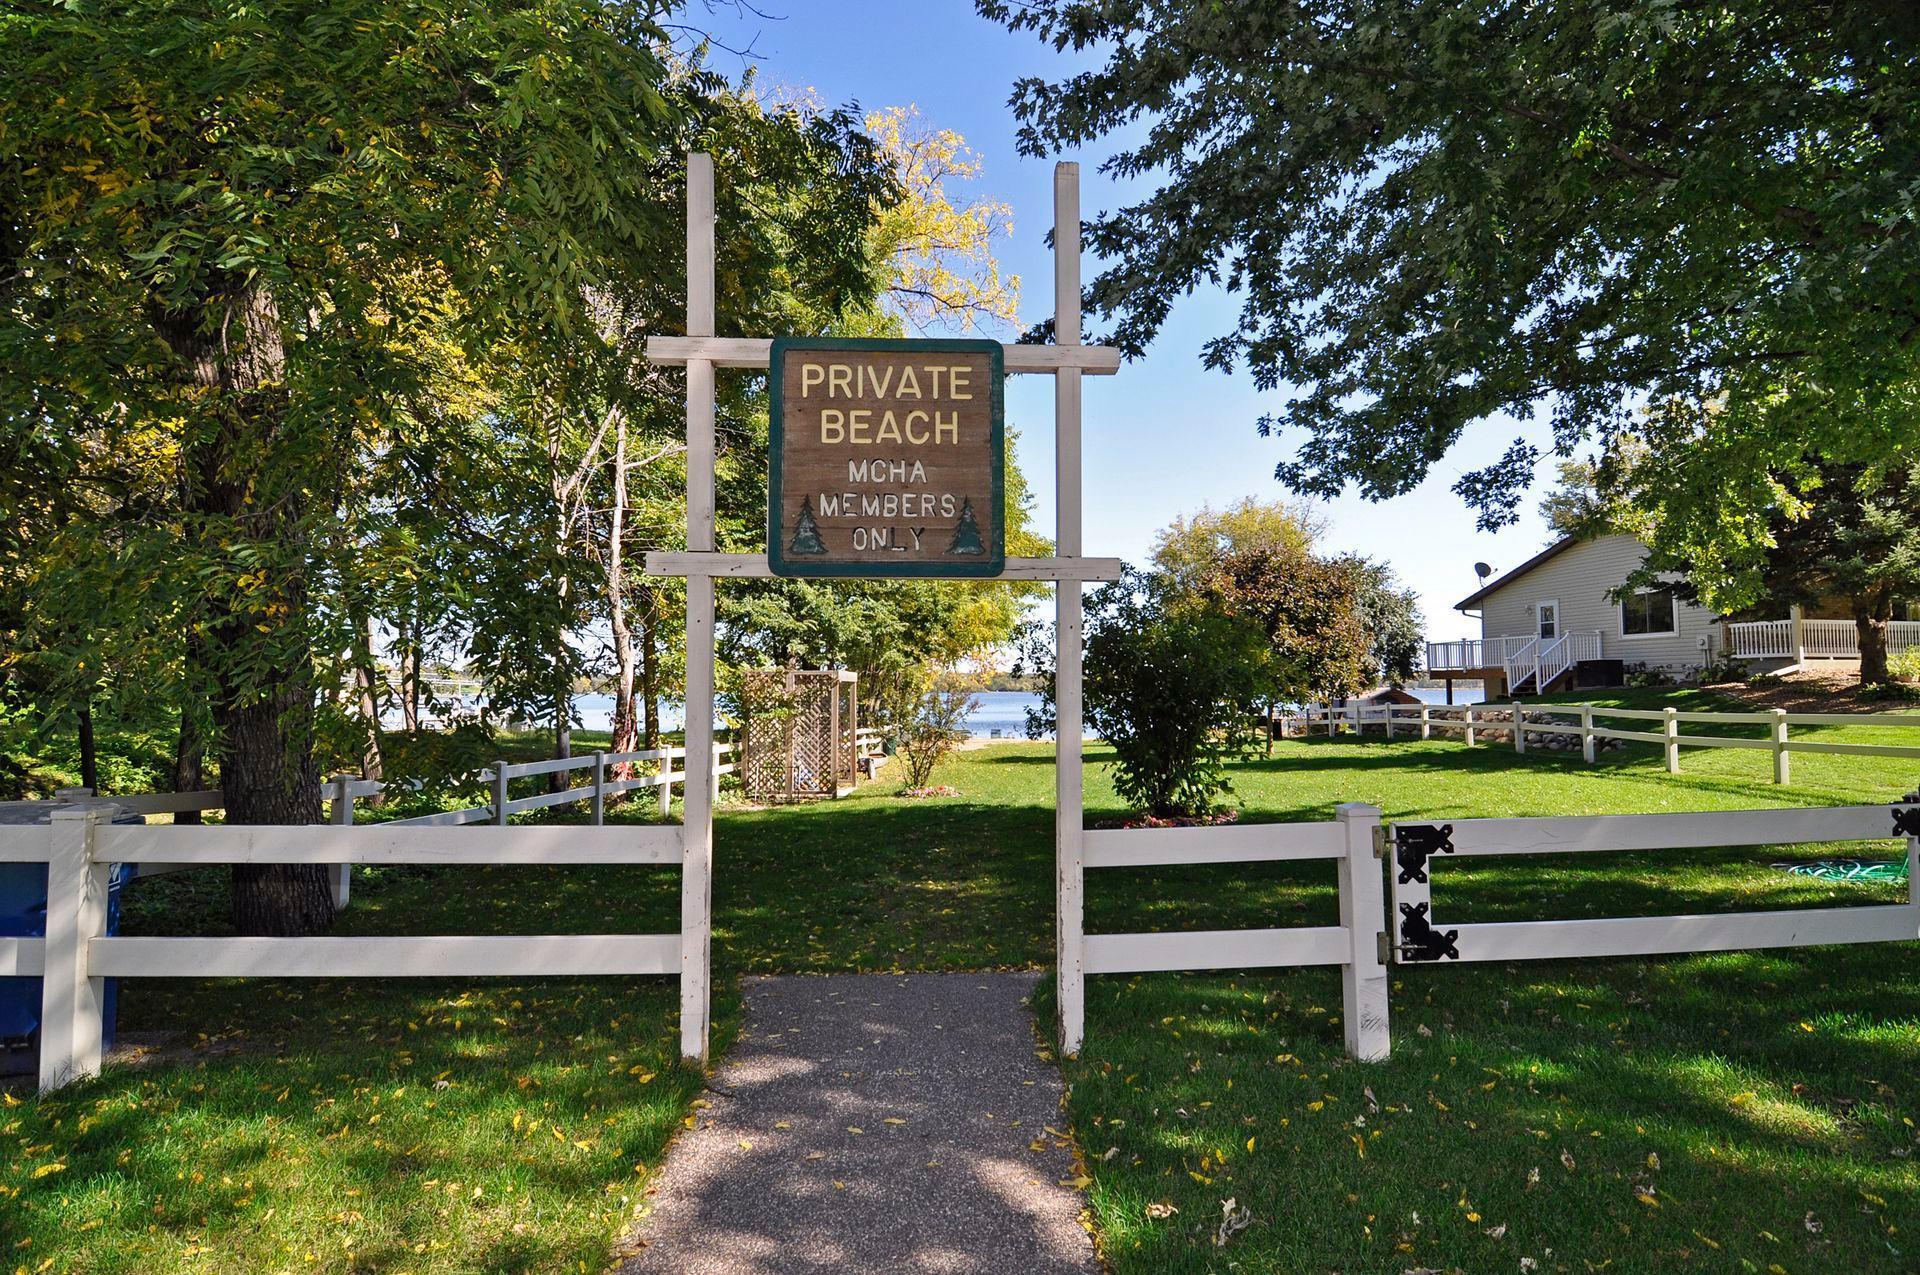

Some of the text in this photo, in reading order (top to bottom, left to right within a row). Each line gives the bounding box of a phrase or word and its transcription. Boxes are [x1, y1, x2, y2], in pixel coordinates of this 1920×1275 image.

[802, 364, 973, 400] PRIVATE
[821, 409, 958, 444] BEACH
[848, 458, 928, 483] MCHA
[819, 493, 956, 518] MEMBERS
[853, 527, 925, 551] ONLY
